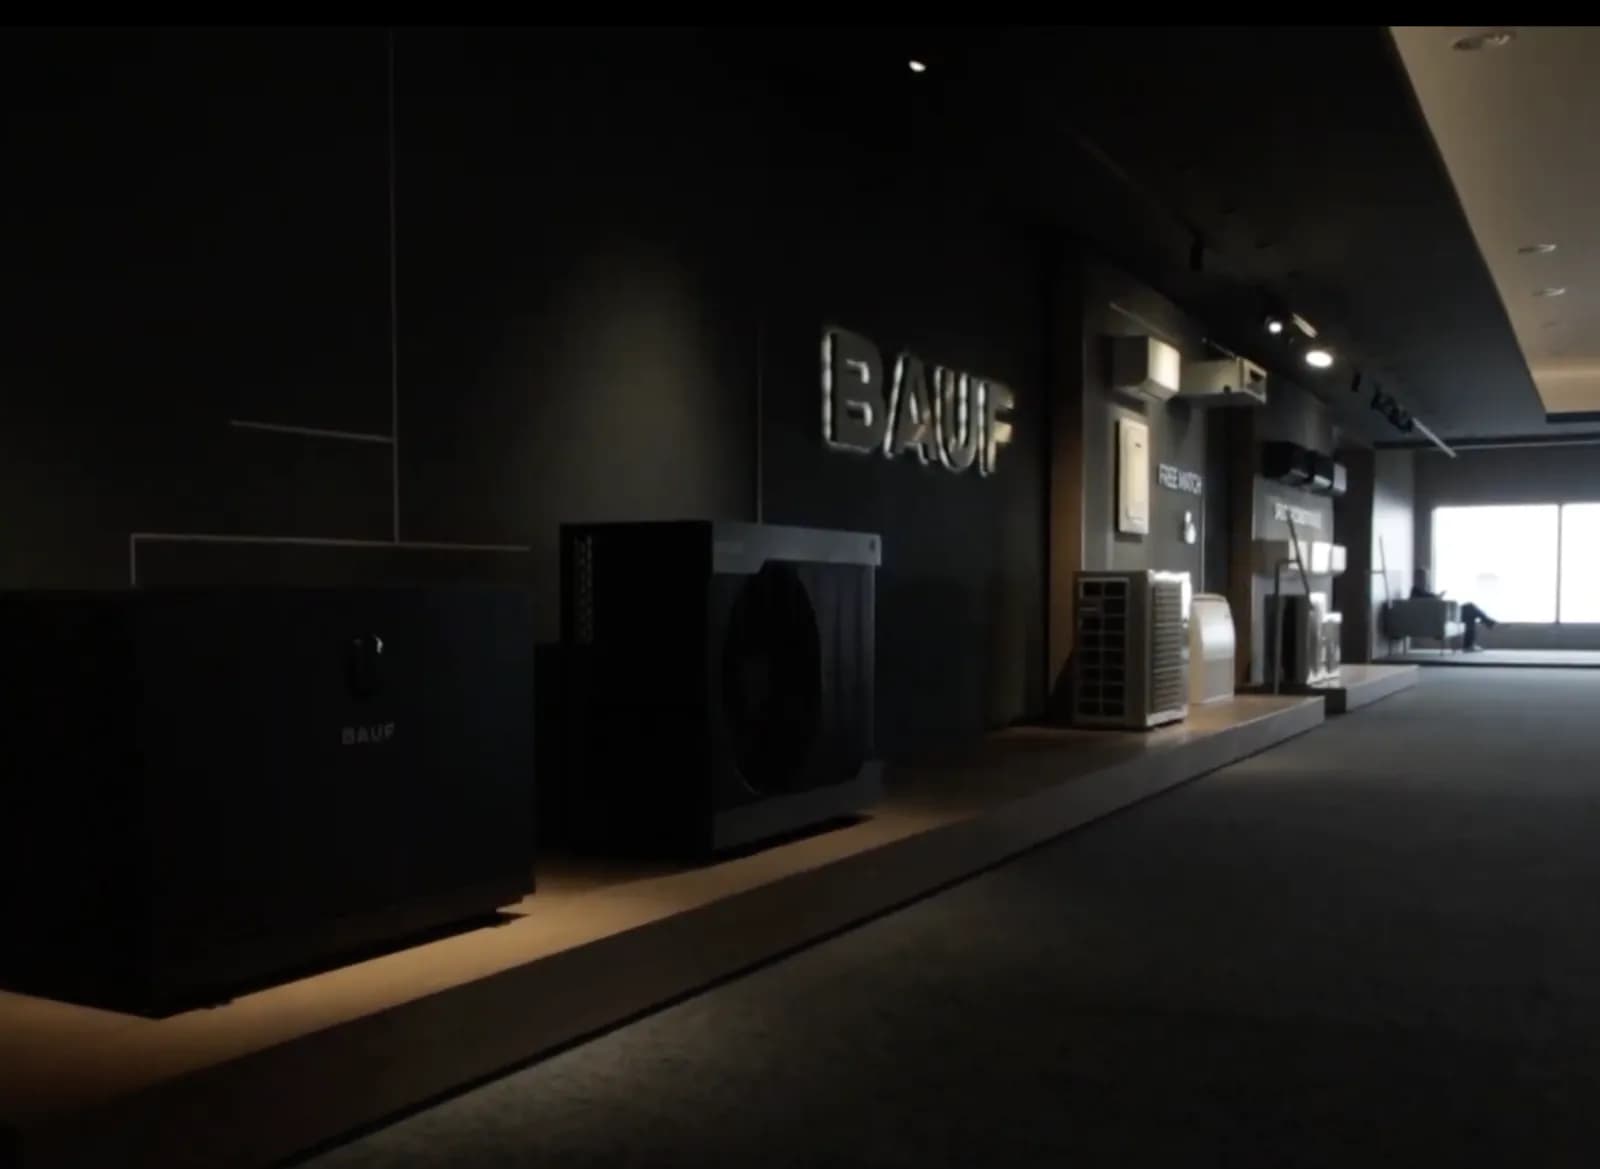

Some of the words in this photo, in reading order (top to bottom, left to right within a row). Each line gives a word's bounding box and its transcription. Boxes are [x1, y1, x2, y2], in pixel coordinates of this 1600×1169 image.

[820, 325, 1015, 477] BAUF
[1158, 463, 1178, 489] FREE
[341, 722, 395, 745] BAUF
